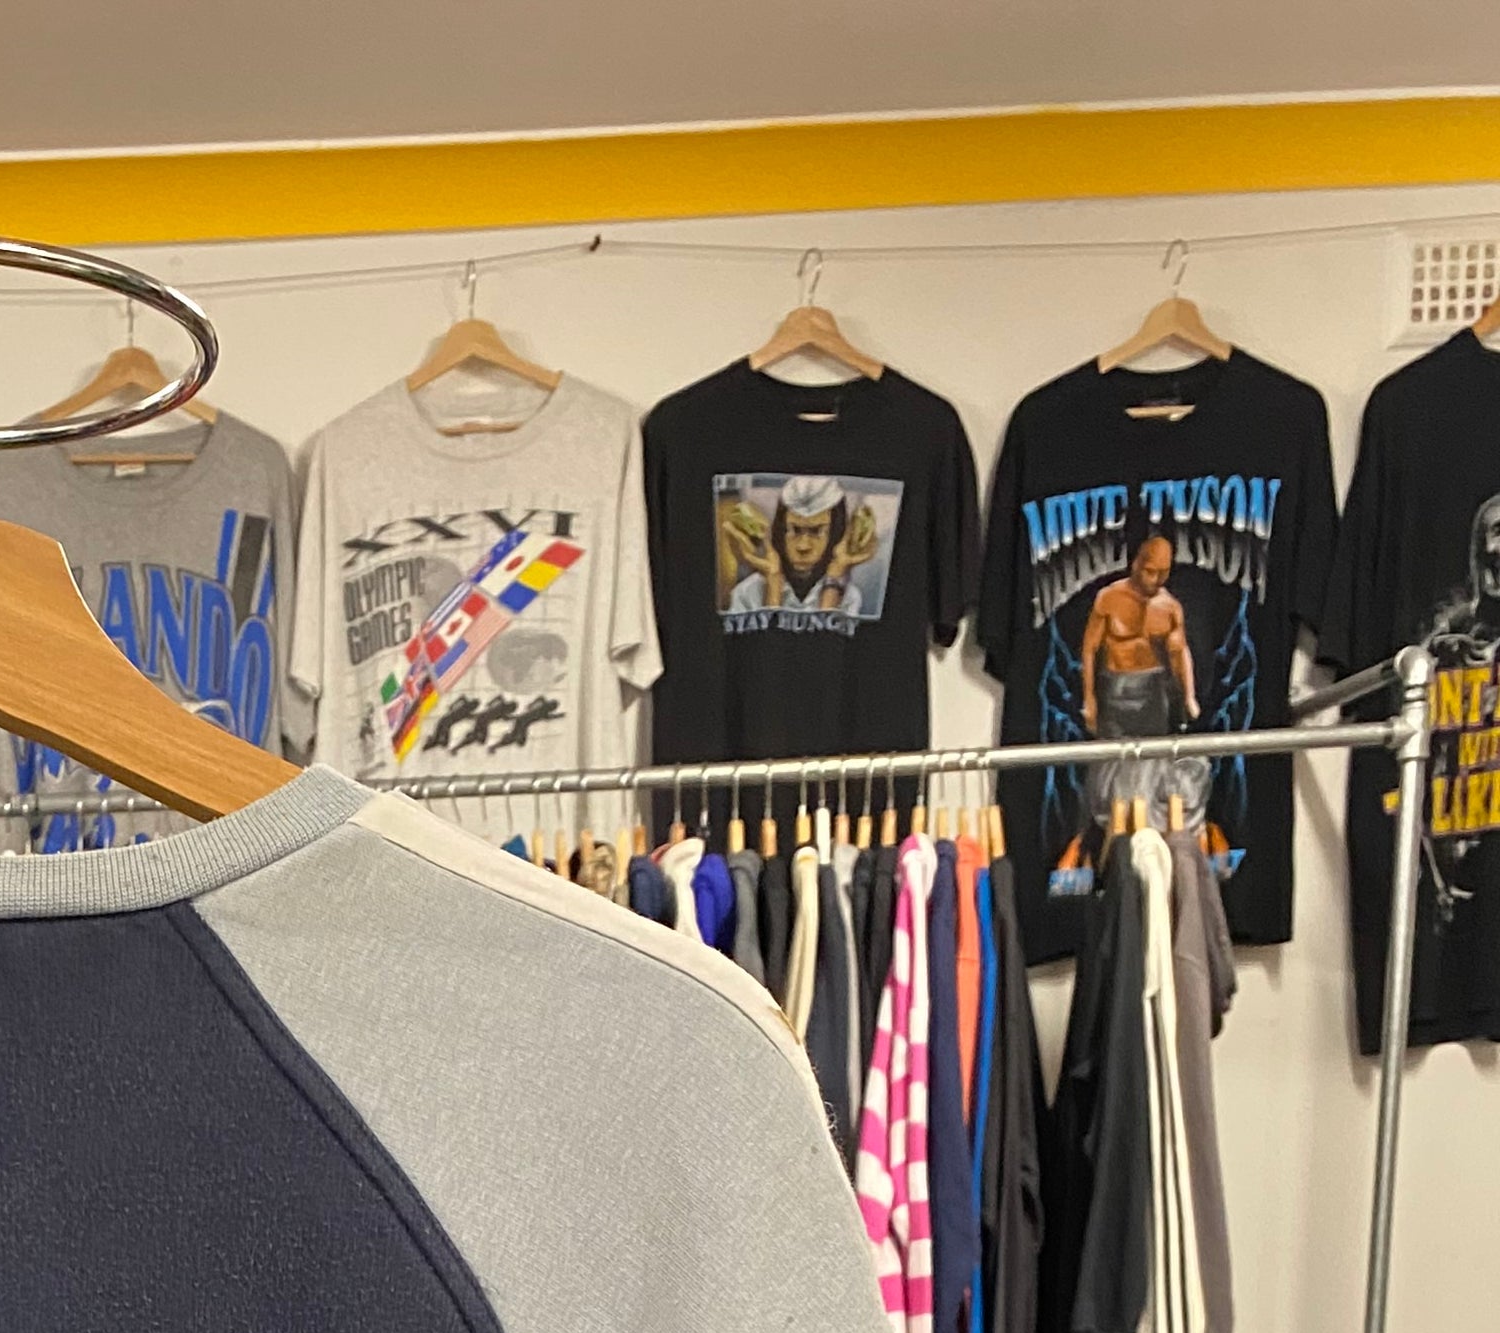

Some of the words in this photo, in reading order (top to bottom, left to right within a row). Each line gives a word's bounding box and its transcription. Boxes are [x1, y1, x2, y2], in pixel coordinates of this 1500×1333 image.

[1139, 474, 1282, 541] TYSON
[343, 555, 427, 623] OLYMPIC
[345, 601, 412, 667] GAMES
